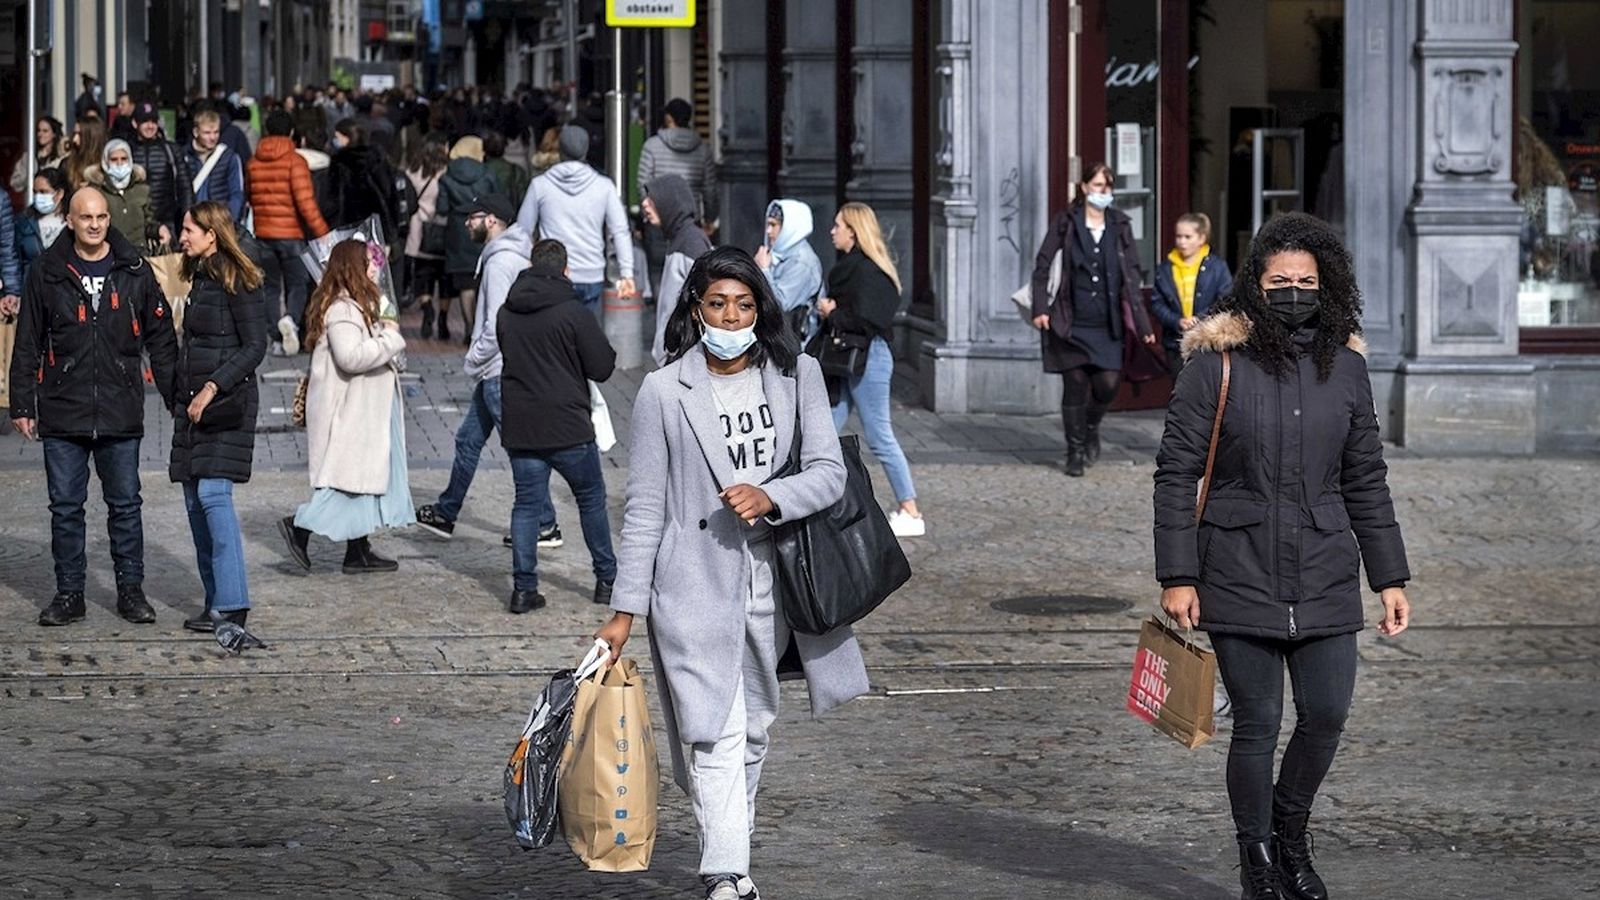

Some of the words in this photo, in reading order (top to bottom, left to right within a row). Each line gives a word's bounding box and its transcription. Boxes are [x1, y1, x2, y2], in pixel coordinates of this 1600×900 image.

[626, 3, 674, 14] obstakel
[727, 437, 777, 471] ME
[1144, 647, 1169, 680] THE
[1140, 669, 1172, 705] ONLY
[1135, 688, 1162, 720] BAG
